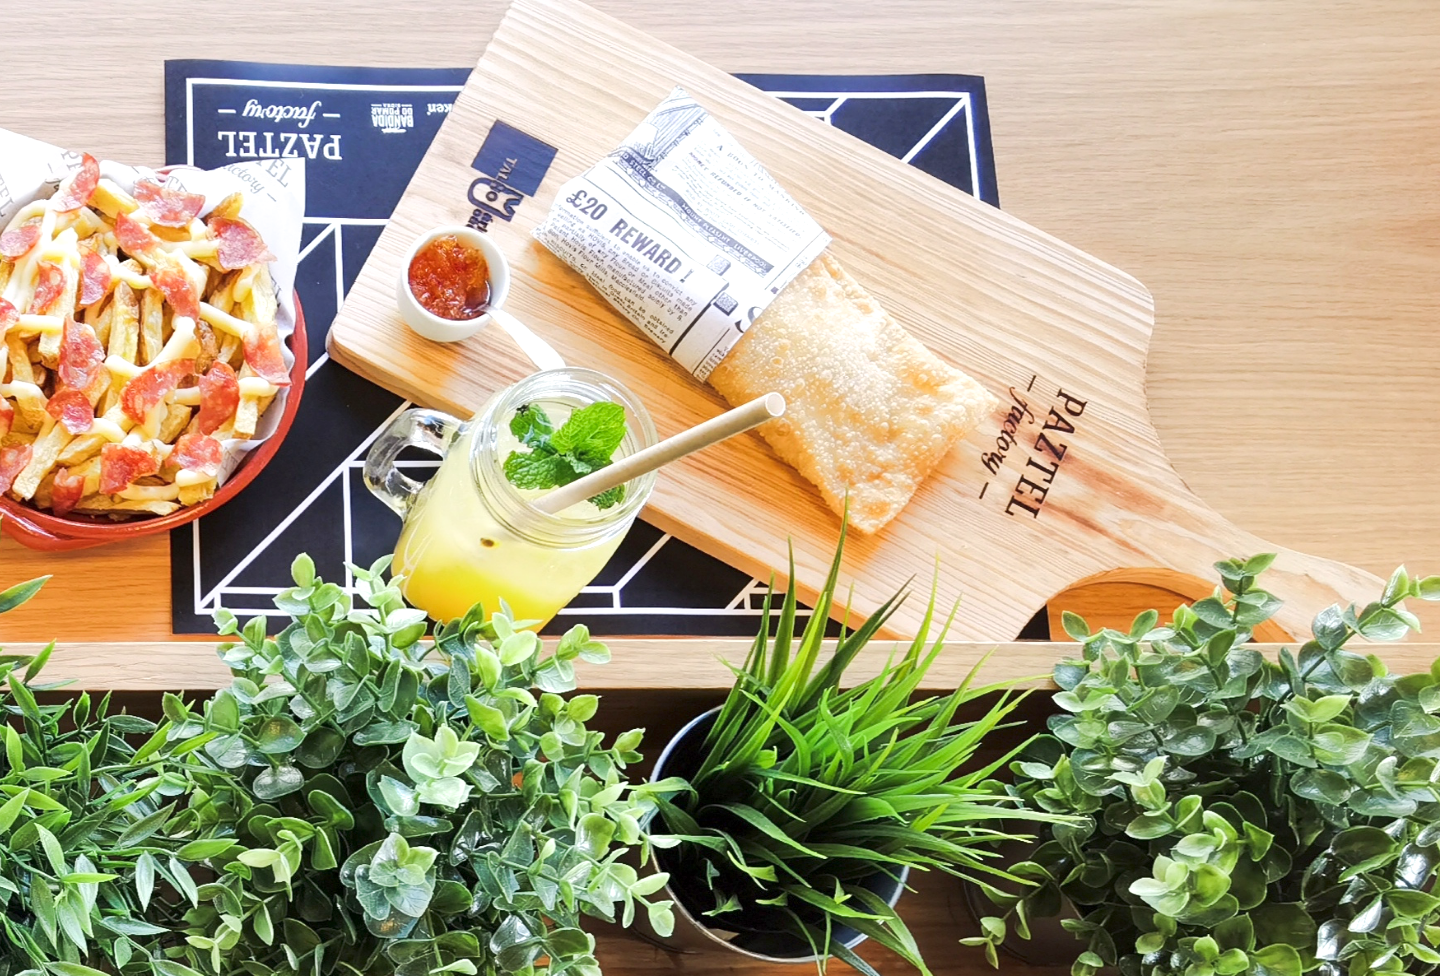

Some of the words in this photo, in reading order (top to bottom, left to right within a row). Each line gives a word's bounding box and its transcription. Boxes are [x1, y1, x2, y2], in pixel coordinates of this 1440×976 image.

[242, 99, 322, 128] factory
[372, 114, 414, 128] BANDIDA
[217, 131, 342, 160] PAZTEL
[628, 159, 647, 176] STEEL
[733, 241, 768, 268] LIVERPOOL
[561, 222, 586, 242] partially
[565, 184, 609, 223] £20
[608, 216, 684, 277] REWARD
[577, 250, 593, 264] Flour
[605, 263, 645, 294] manufactured
[660, 277, 683, 296] convict
[648, 313, 674, 335] obtained
[981, 386, 1035, 476] factory
[1004, 388, 1088, 519] PAZTEL
